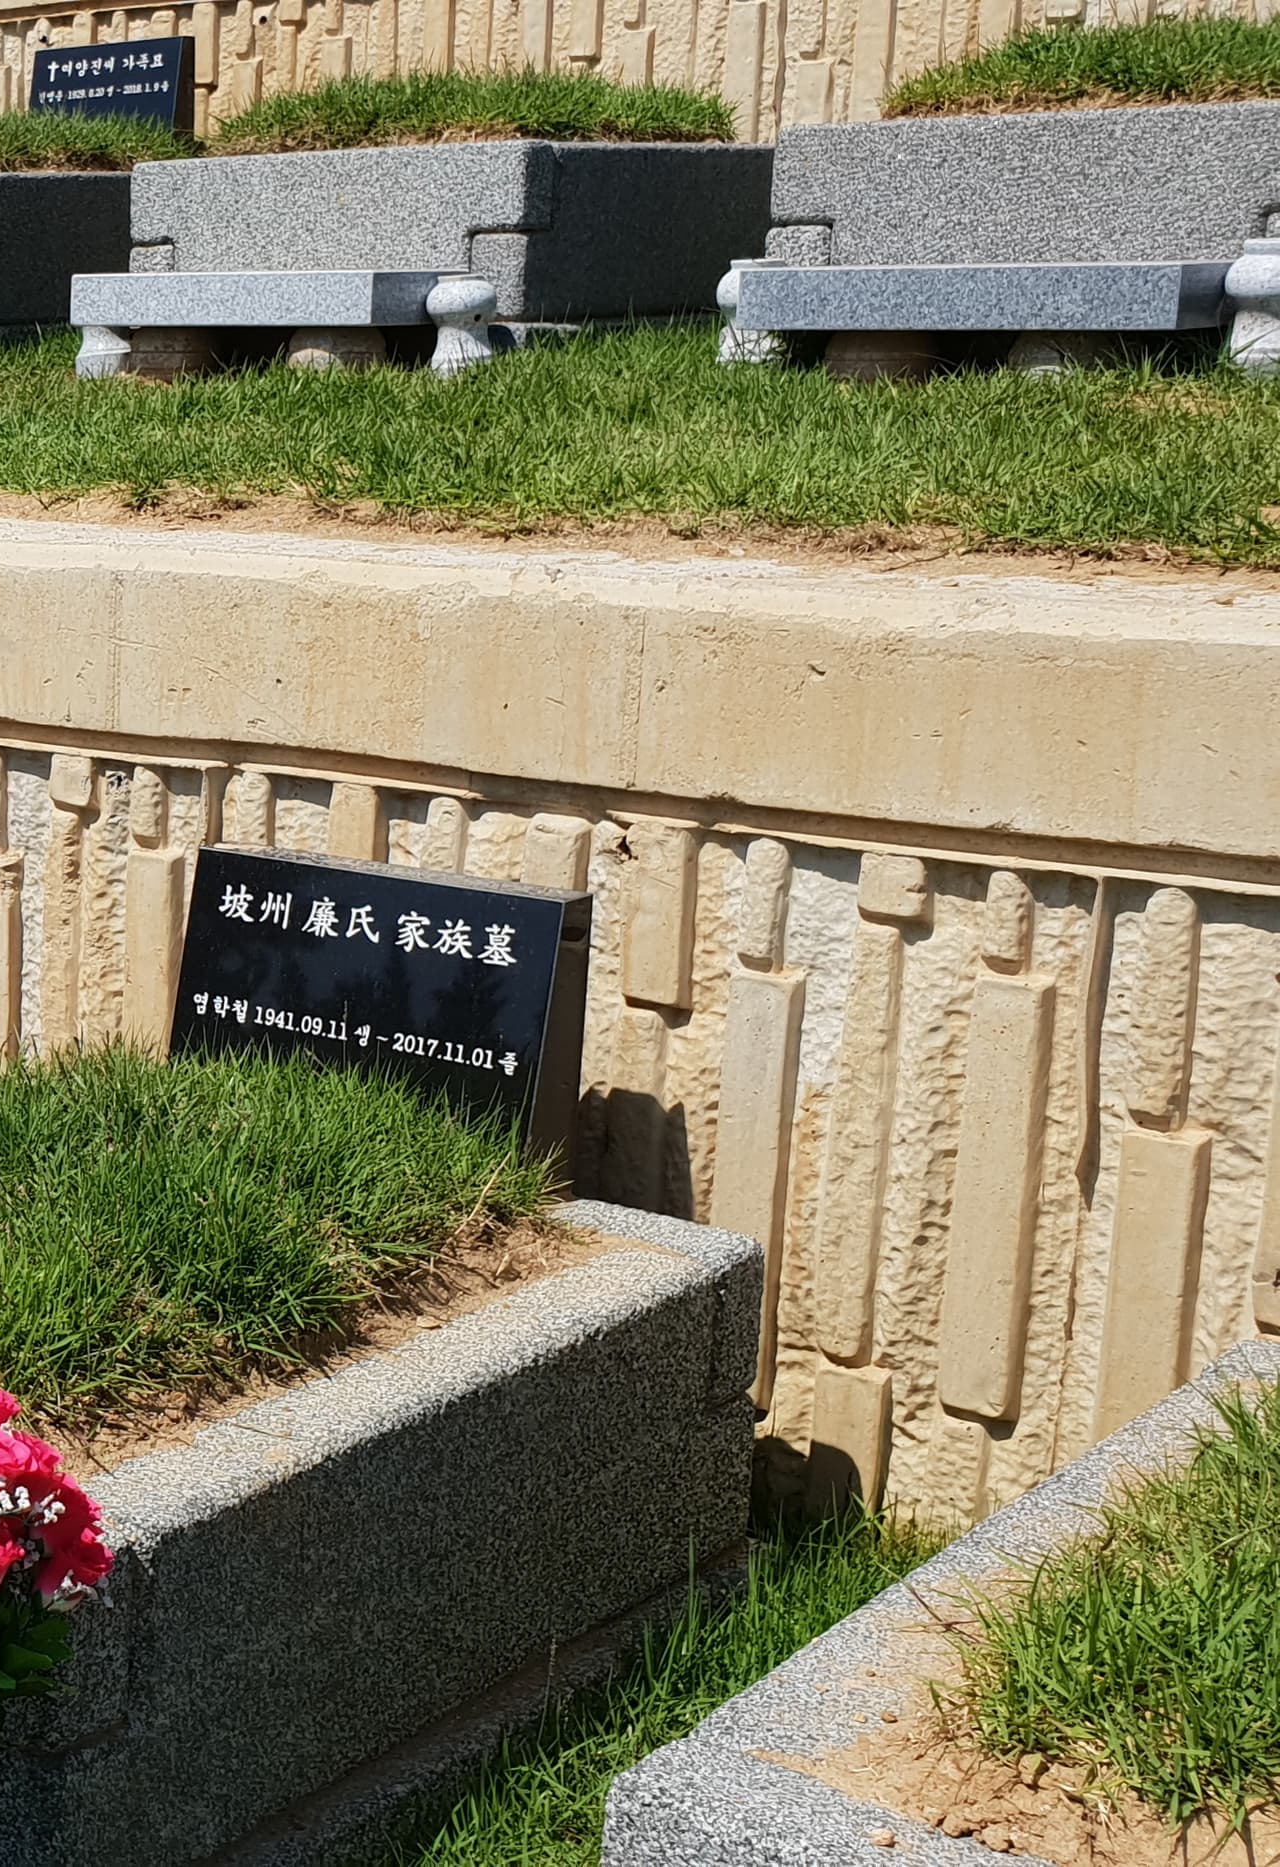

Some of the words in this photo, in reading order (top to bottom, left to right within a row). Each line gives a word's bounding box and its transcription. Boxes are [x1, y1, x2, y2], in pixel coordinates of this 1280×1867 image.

[122, 53, 164, 71] 가족묘
[218, 883, 293, 930] 坡州
[301, 896, 380, 944] 廉氏
[394, 910, 517, 967] 家族墓
[193, 991, 249, 1024] 염학철
[253, 1006, 348, 1041] 1941.09.11
[353, 1024, 371, 1047] 생
[392, 1032, 493, 1069] 2017.11.01
[497, 1051, 519, 1076] 졸
